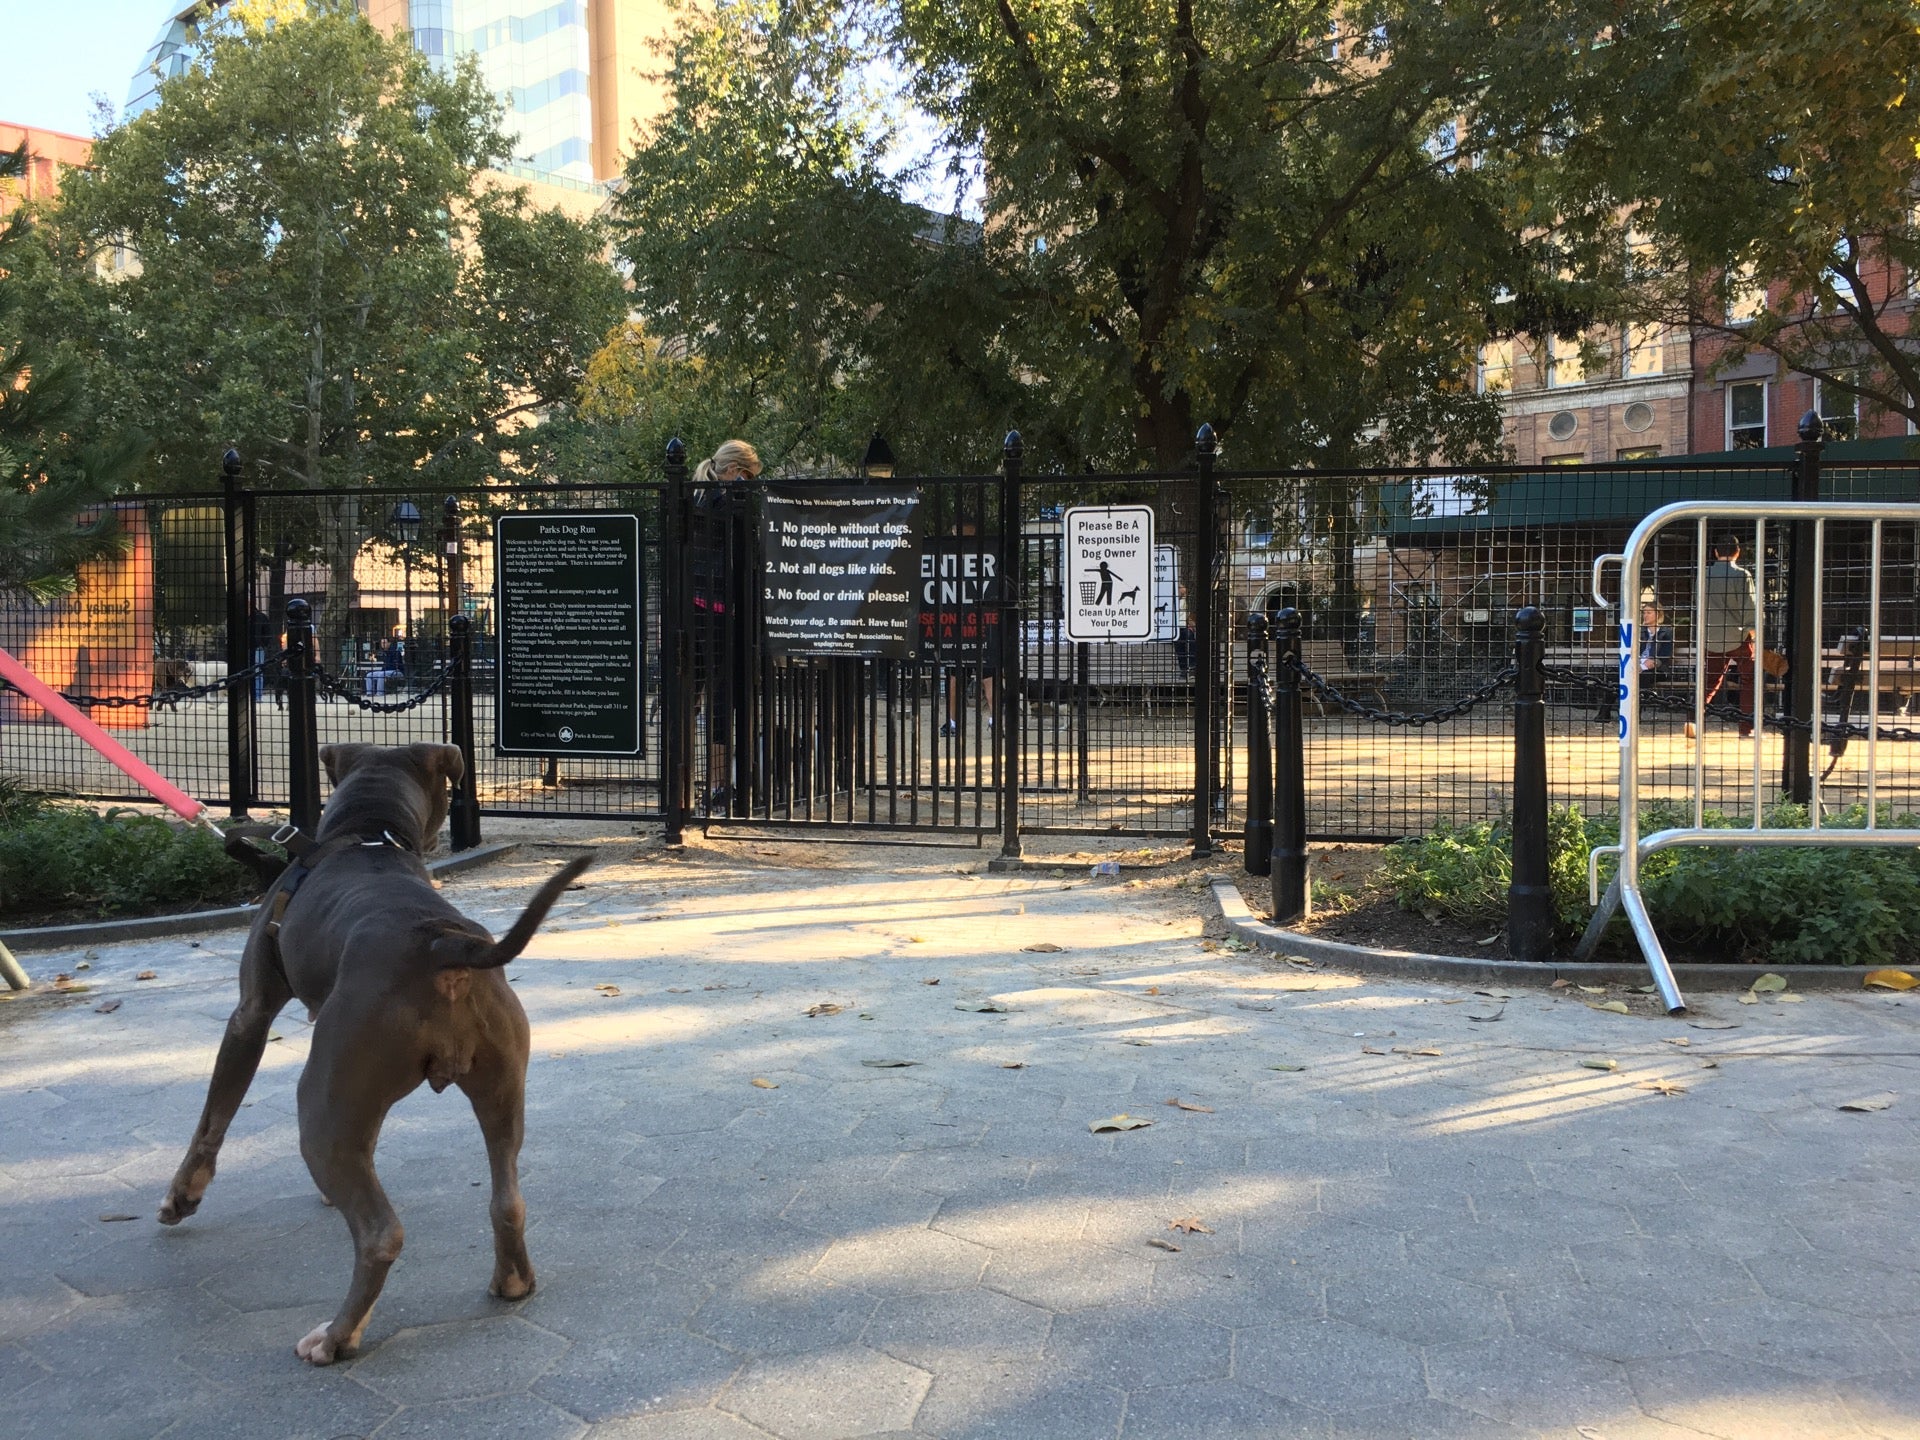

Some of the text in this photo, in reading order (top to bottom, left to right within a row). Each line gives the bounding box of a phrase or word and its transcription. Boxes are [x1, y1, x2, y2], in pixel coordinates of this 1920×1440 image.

[767, 496, 794, 504] Welcome
[893, 497, 906, 506] Dog
[540, 525, 596, 535] Parks Dog Run
[768, 521, 912, 536] 1. No people without dogs.
[1078, 520, 1139, 530] Please Be A
[782, 536, 912, 550] No dogs without people.
[1078, 534, 1140, 546] Responsible
[1082, 549, 1136, 560] Dog Owner
[766, 561, 896, 576] 2. Not all dogs like kids.
[921, 554, 996, 577] ENTER
[764, 588, 910, 603] 3. No food or drink please!
[967, 612, 998, 625] GTE
[1105, 609, 1116, 618] Up
[1119, 608, 1140, 616] After
[766, 616, 788, 624] Watch
[810, 618, 826, 627] dog.
[828, 618, 838, 626] Be
[840, 618, 865, 626] smart.
[868, 618, 888, 627] Have
[891, 619, 908, 628] fun!
[1111, 620, 1128, 628] Dog
